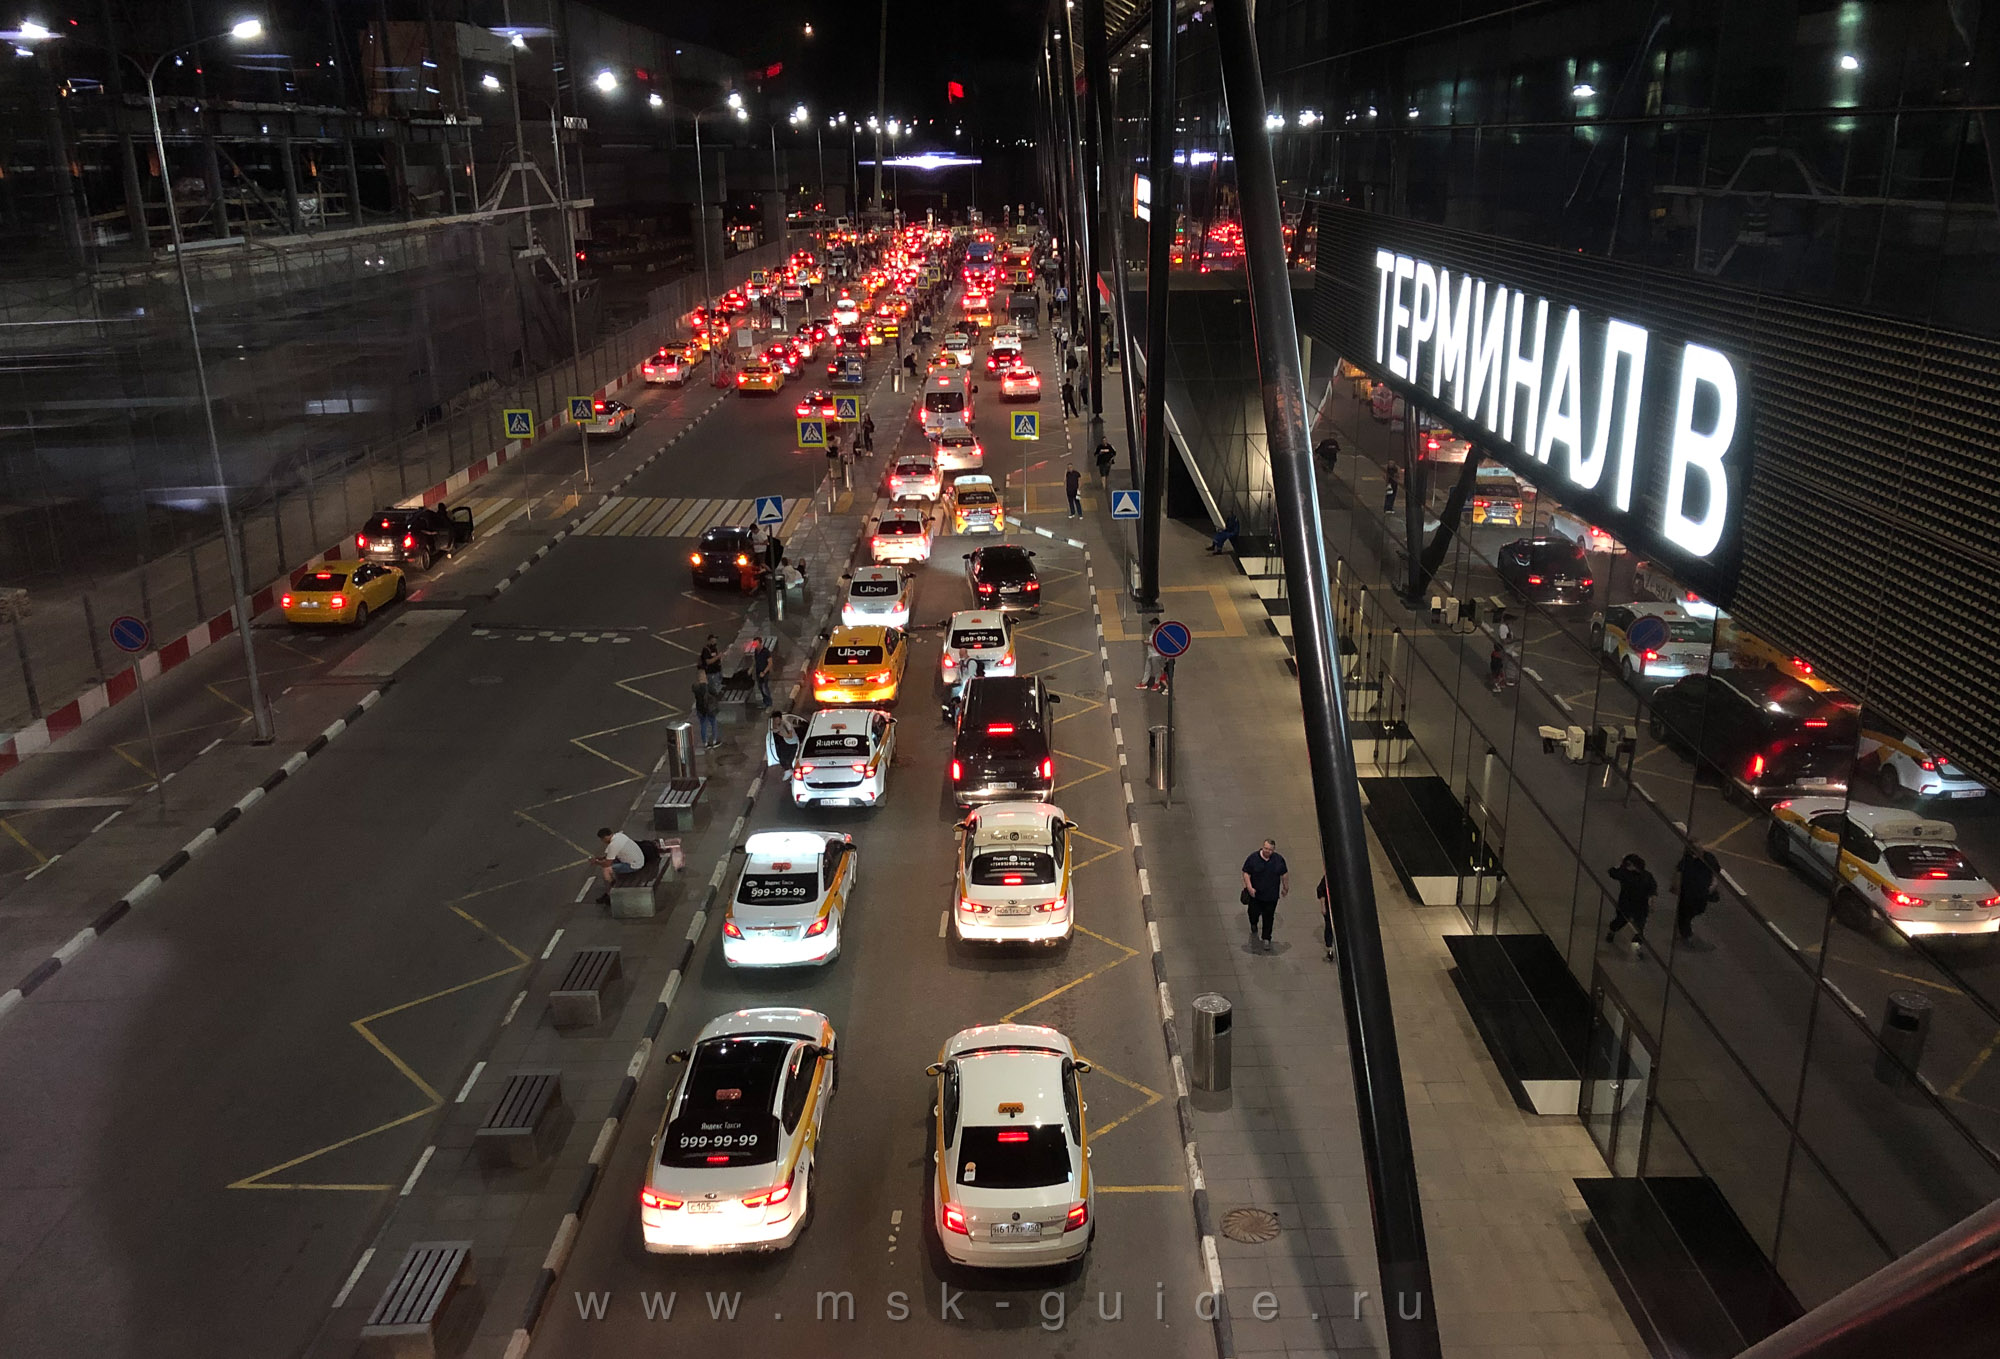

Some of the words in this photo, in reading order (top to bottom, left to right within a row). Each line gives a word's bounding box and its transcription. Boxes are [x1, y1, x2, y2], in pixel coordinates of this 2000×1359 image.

[1376, 248, 1649, 513] ТЕРМИНАЛ
[1663, 341, 1739, 557] В
[860, 585, 888, 593] Uber
[837, 648, 870, 657] Uber
[751, 887, 806, 897] 999-99-99
[701, 1122, 723, 1131] Яндекс
[724, 1121, 742, 1129] Такси
[680, 1134, 758, 1148] 999-99-99
